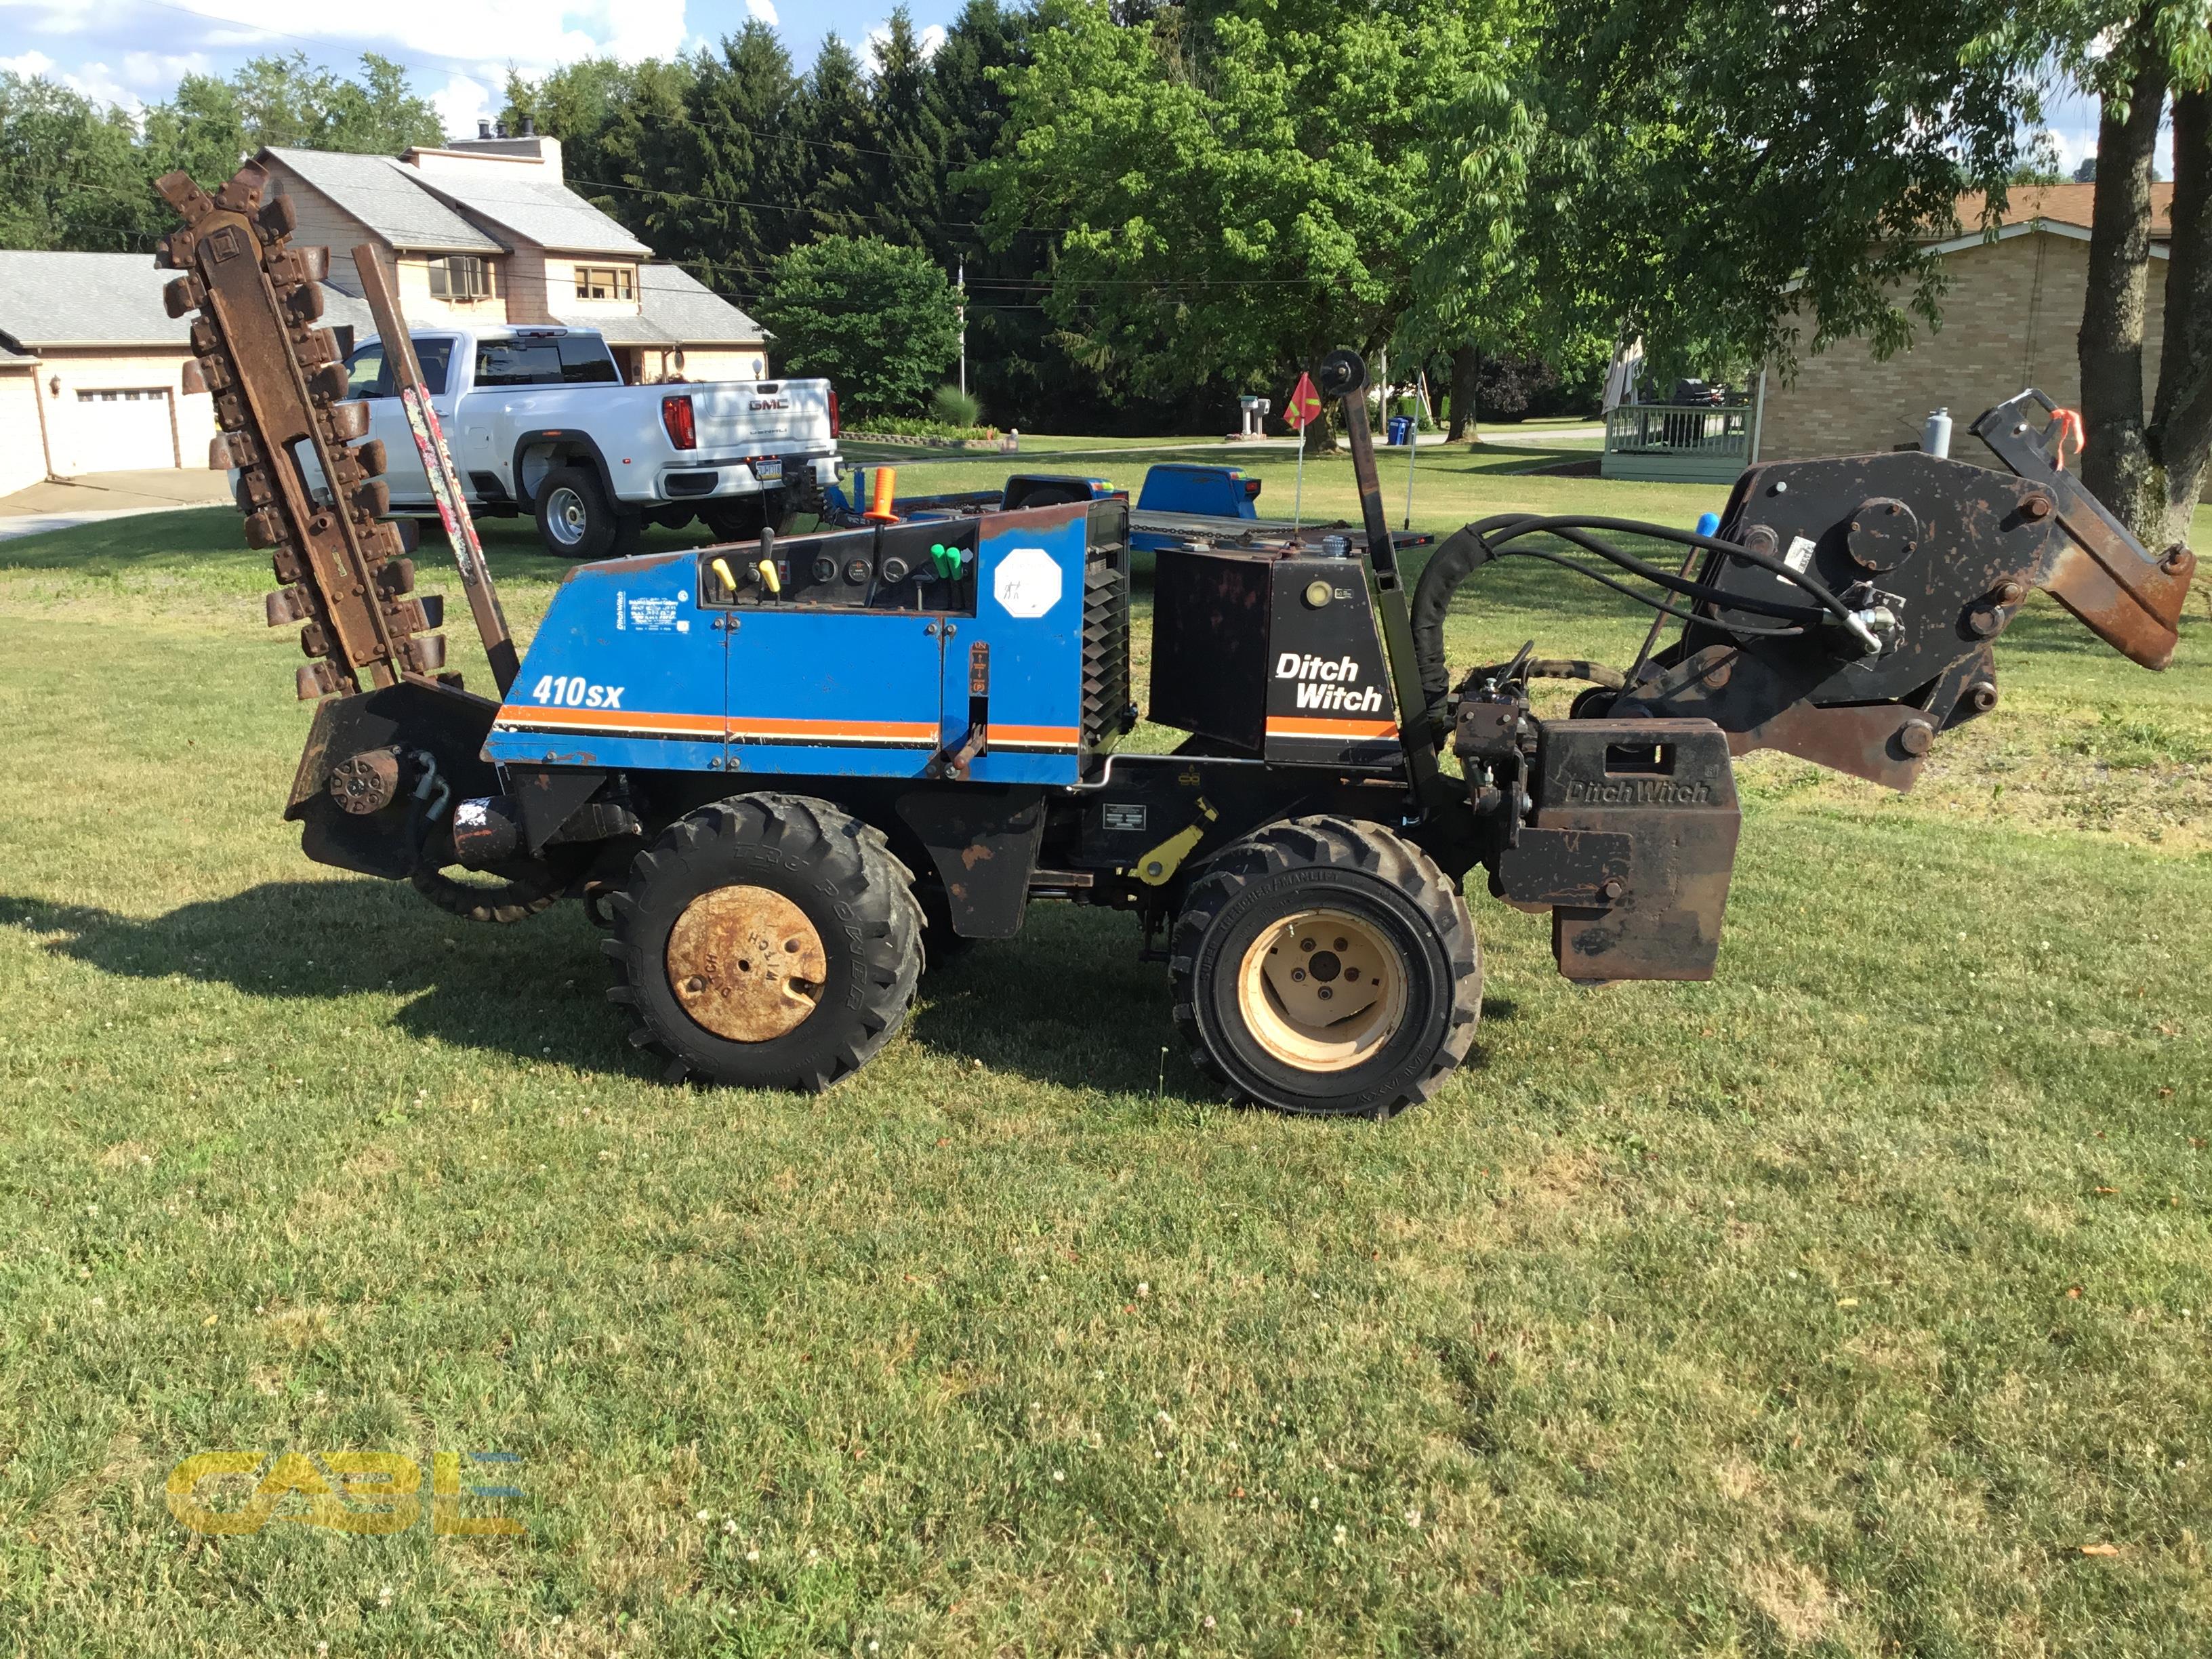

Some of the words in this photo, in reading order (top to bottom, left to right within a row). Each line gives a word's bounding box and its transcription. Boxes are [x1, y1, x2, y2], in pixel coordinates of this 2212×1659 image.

[748, 398, 789, 411] GMC
[1275, 653, 1359, 682] Ditch
[1296, 682, 1382, 712] Witch
[1565, 781, 1633, 802] Ditch
[1637, 781, 1711, 802] Witch
[747, 932, 780, 981] WITCH
[705, 953, 731, 998] DITCH
